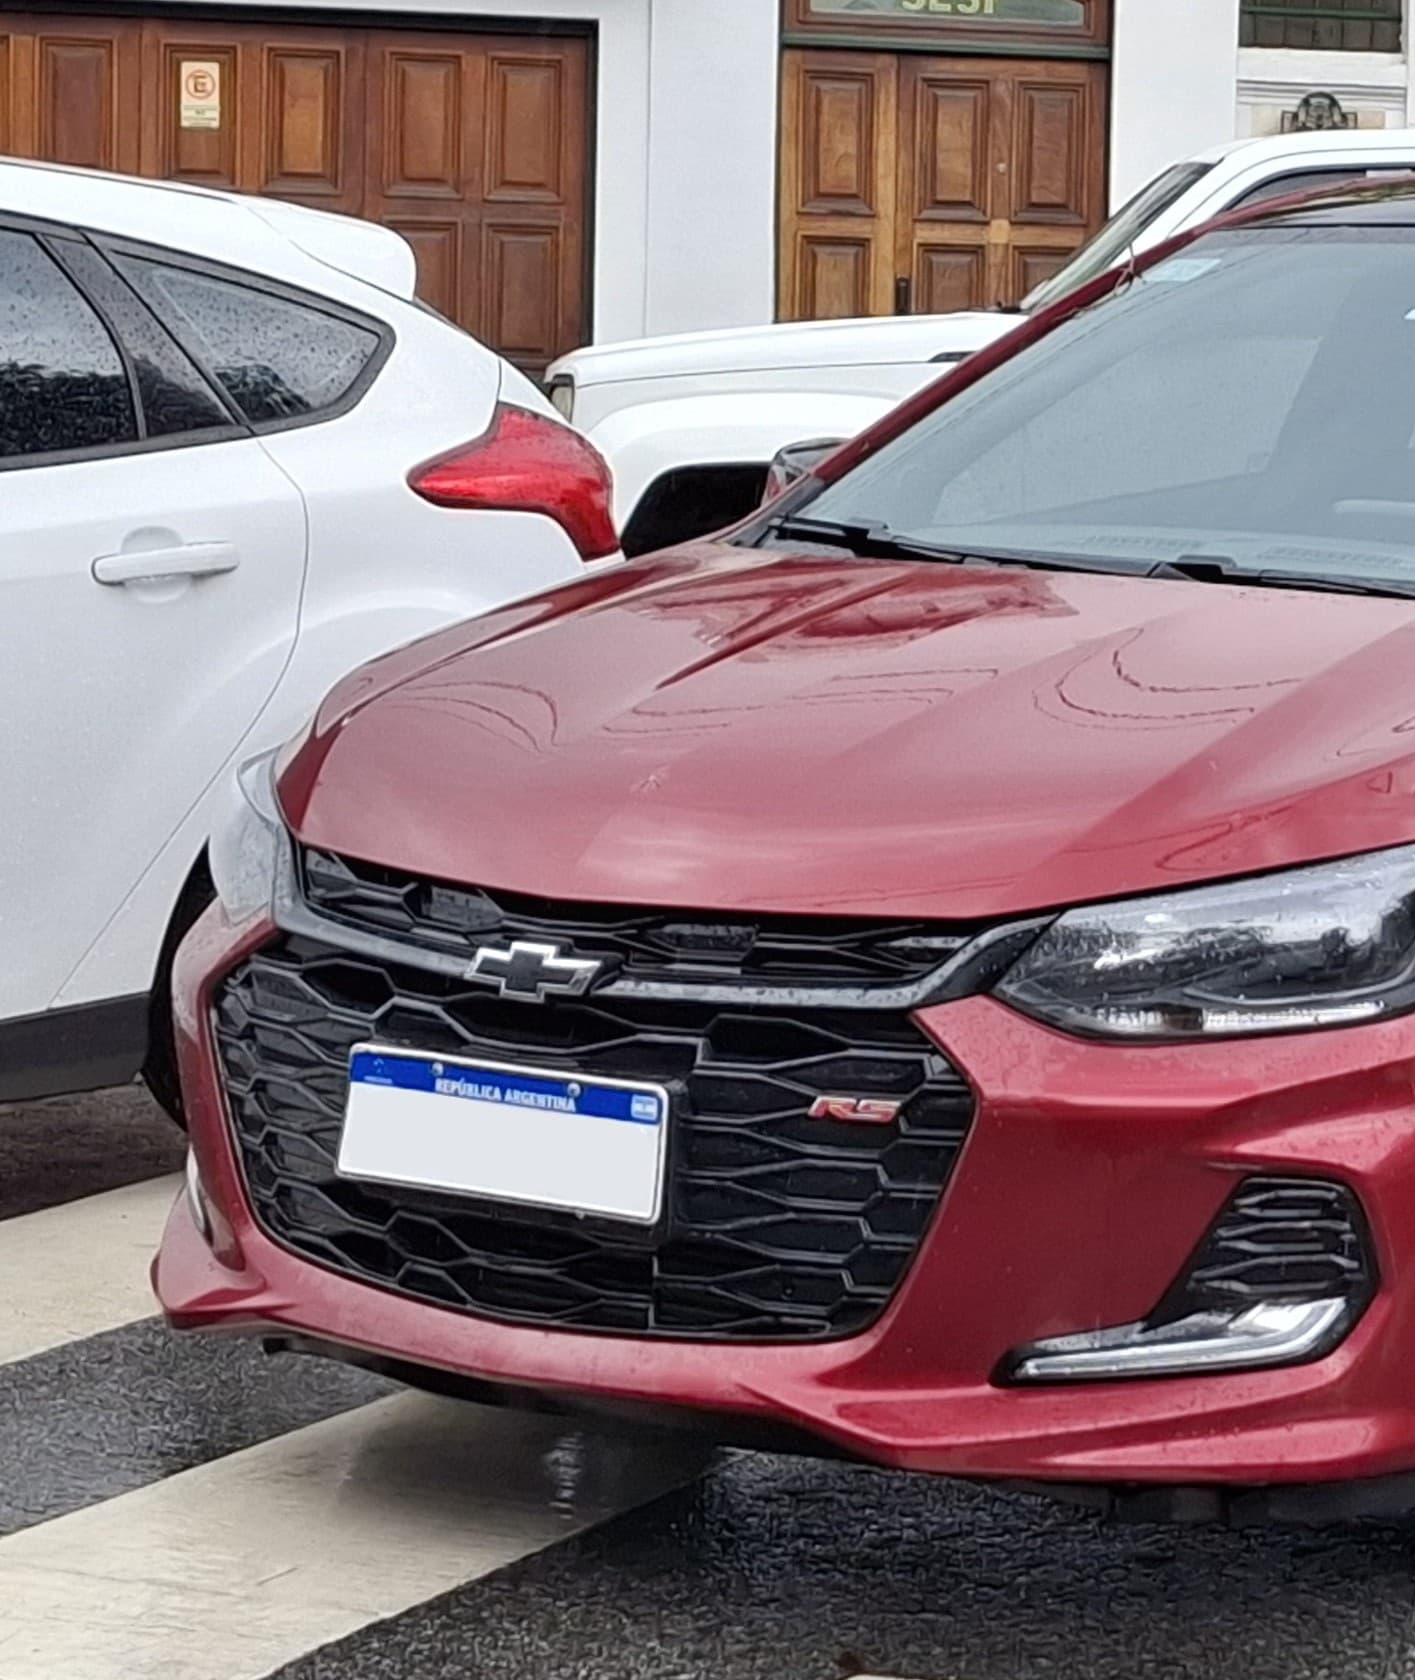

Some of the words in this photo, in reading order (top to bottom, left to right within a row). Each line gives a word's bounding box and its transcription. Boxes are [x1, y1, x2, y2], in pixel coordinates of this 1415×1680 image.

[193, 75, 207, 93] E
[434, 1077, 502, 1101] REPÚBLICA
[504, 1088, 576, 1113] ARGENTINA
[807, 1095, 901, 1123] RS
